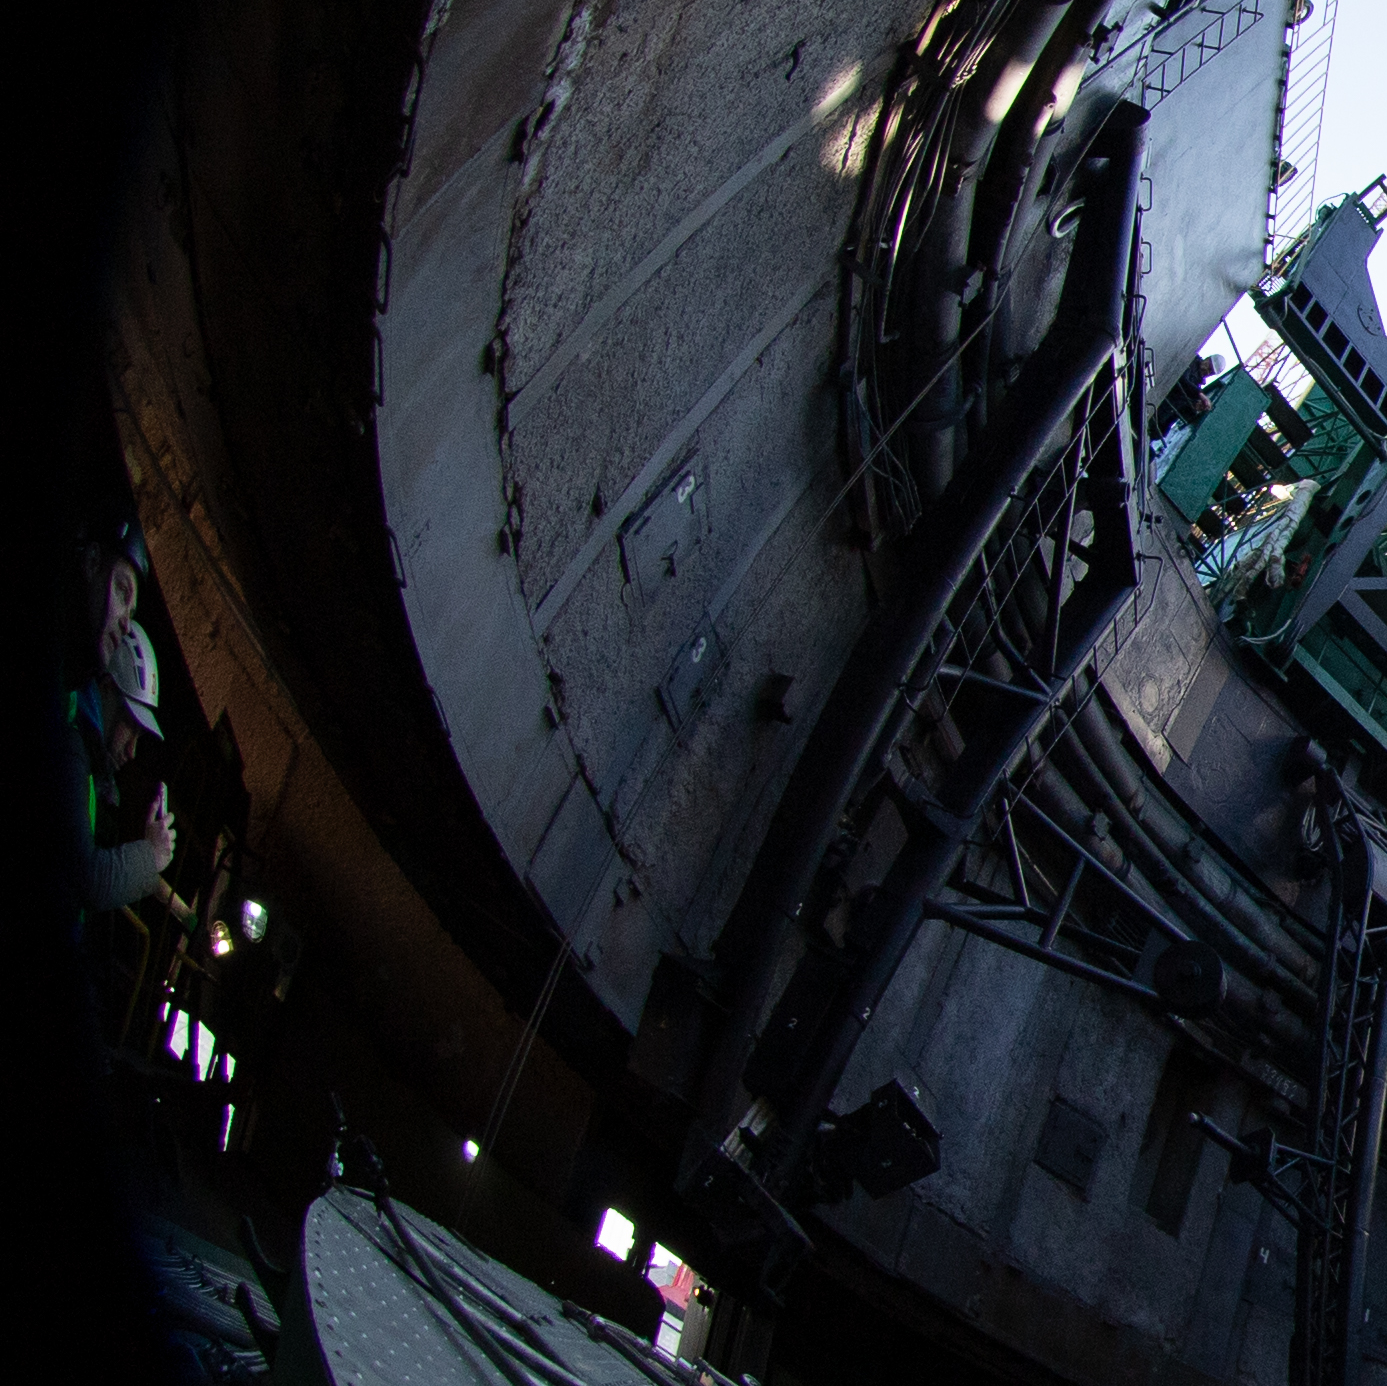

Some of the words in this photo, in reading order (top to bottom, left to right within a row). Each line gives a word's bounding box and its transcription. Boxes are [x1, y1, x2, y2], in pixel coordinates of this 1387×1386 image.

[676, 475, 696, 503] 3
[692, 637, 708, 663] 3
[862, 1006, 871, 1021] 2
[787, 1017, 798, 1030] 2
[1259, 1247, 1270, 1264] 4
